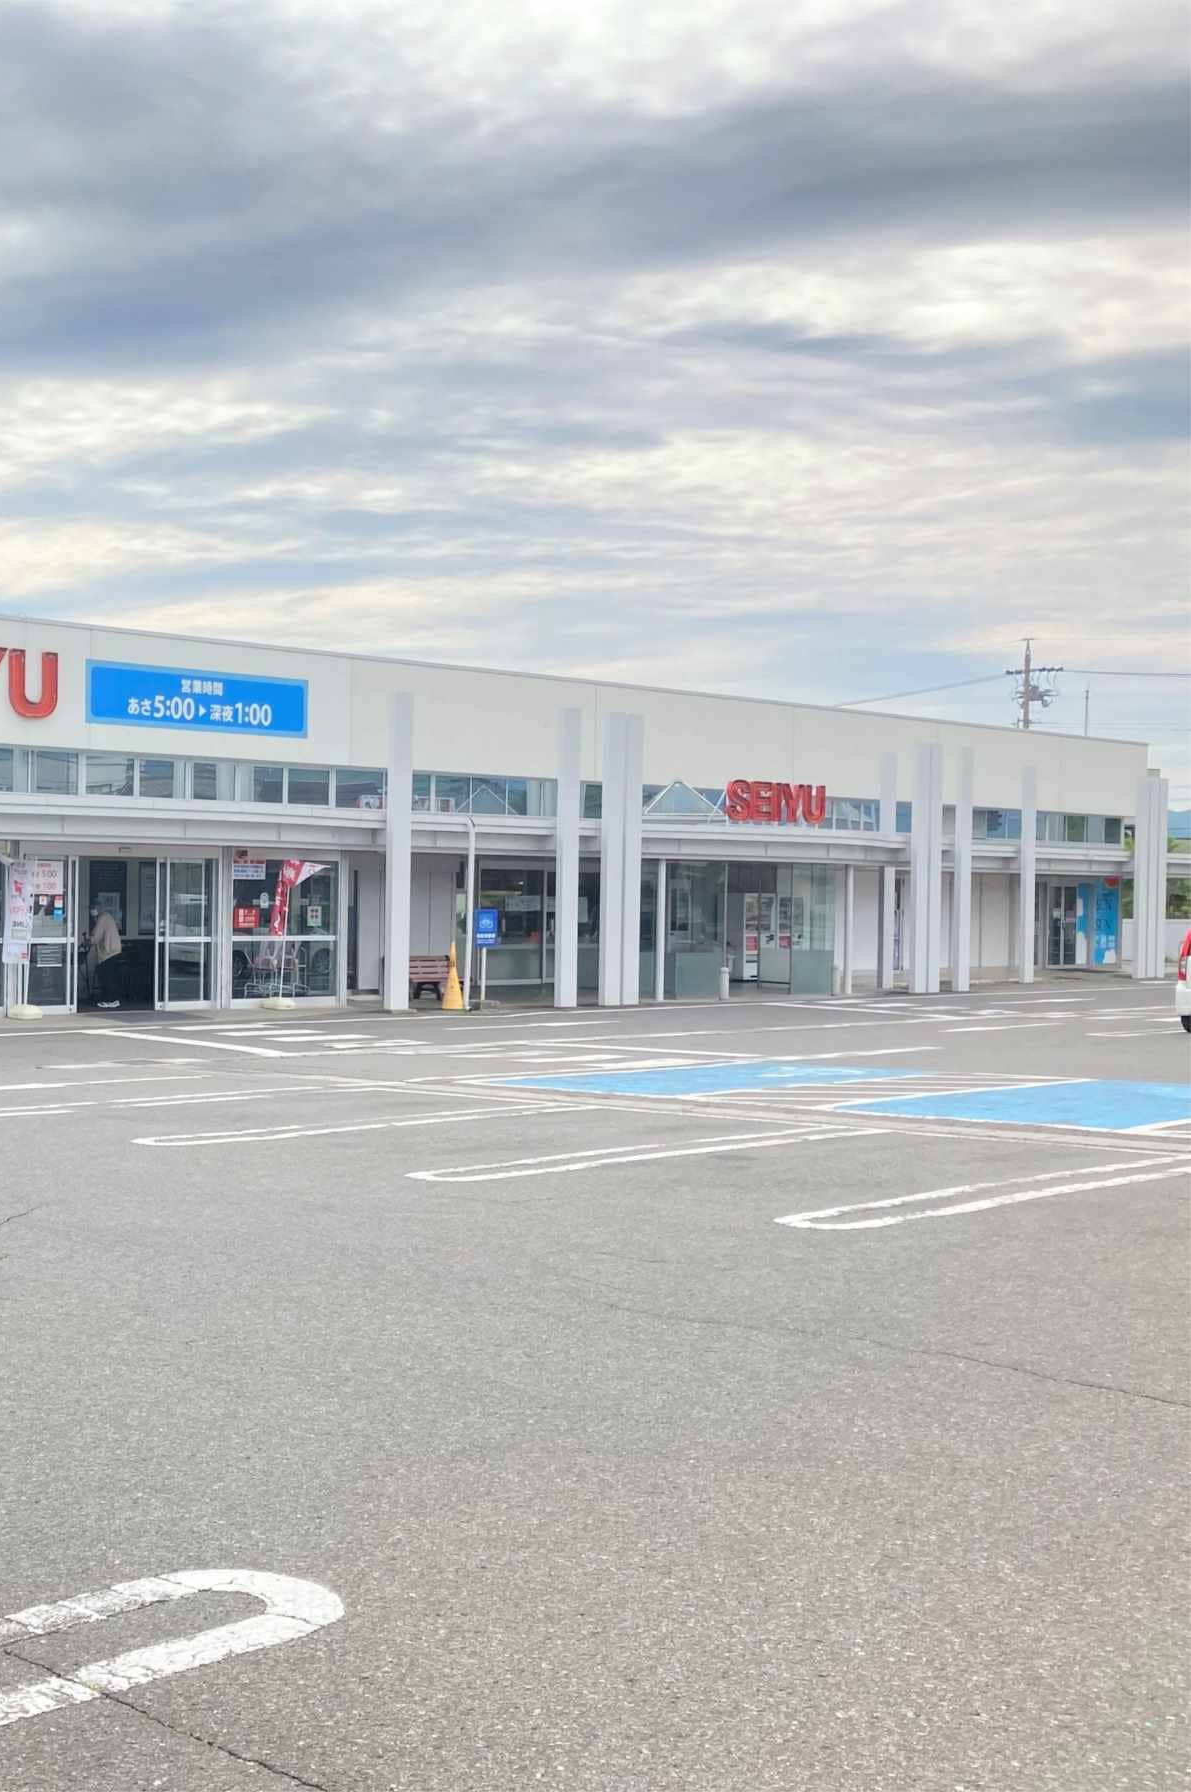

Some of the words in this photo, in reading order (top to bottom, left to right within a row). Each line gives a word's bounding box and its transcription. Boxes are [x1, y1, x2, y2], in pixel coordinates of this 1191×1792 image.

[180, 679, 224, 697] 営業時間
[127, 696, 195, 721] あさ5:00
[210, 703, 273, 727] 深夜1:00
[727, 780, 826, 823] SEIYU
